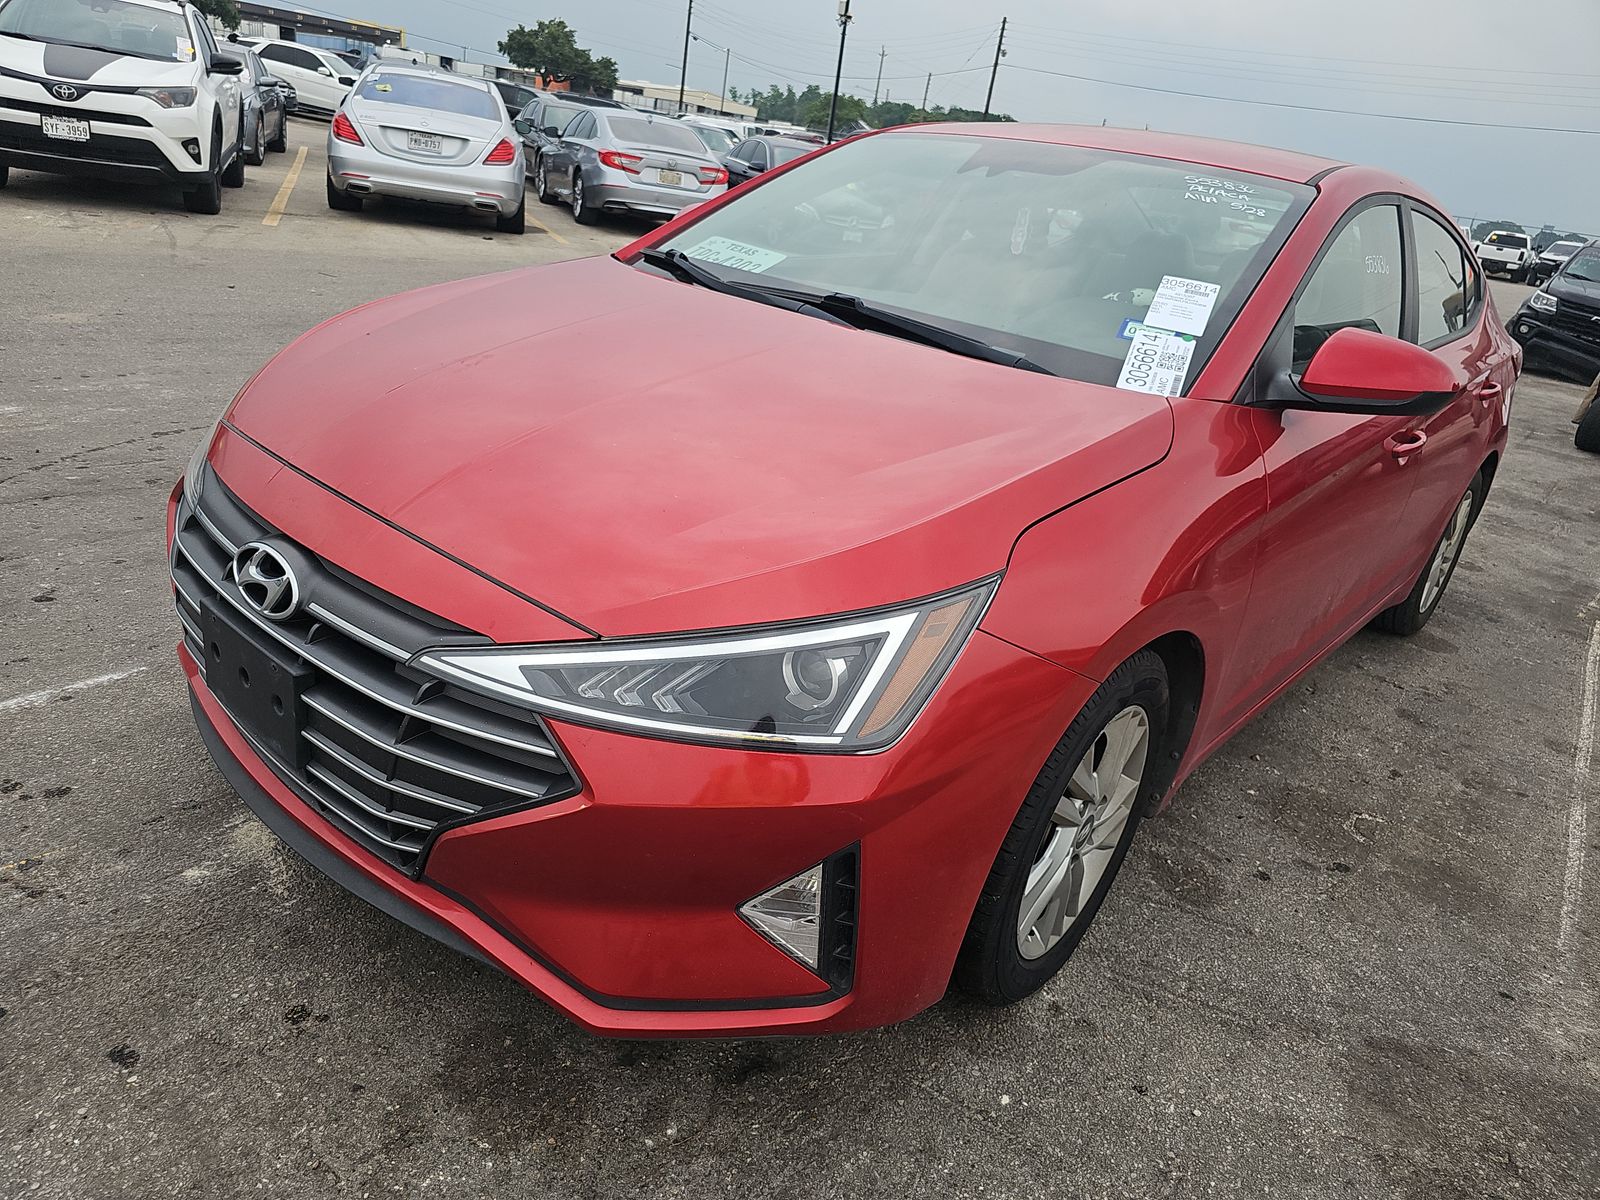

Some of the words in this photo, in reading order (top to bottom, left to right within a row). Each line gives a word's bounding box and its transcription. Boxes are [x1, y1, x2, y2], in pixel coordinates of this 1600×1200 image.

[44, 122, 88, 137] SYF-3959
[726, 243, 759, 257] TEXAS
[1161, 277, 1218, 294] 3056614
[1125, 333, 1163, 387] 3056614
[1156, 376, 1169, 395] AMC
